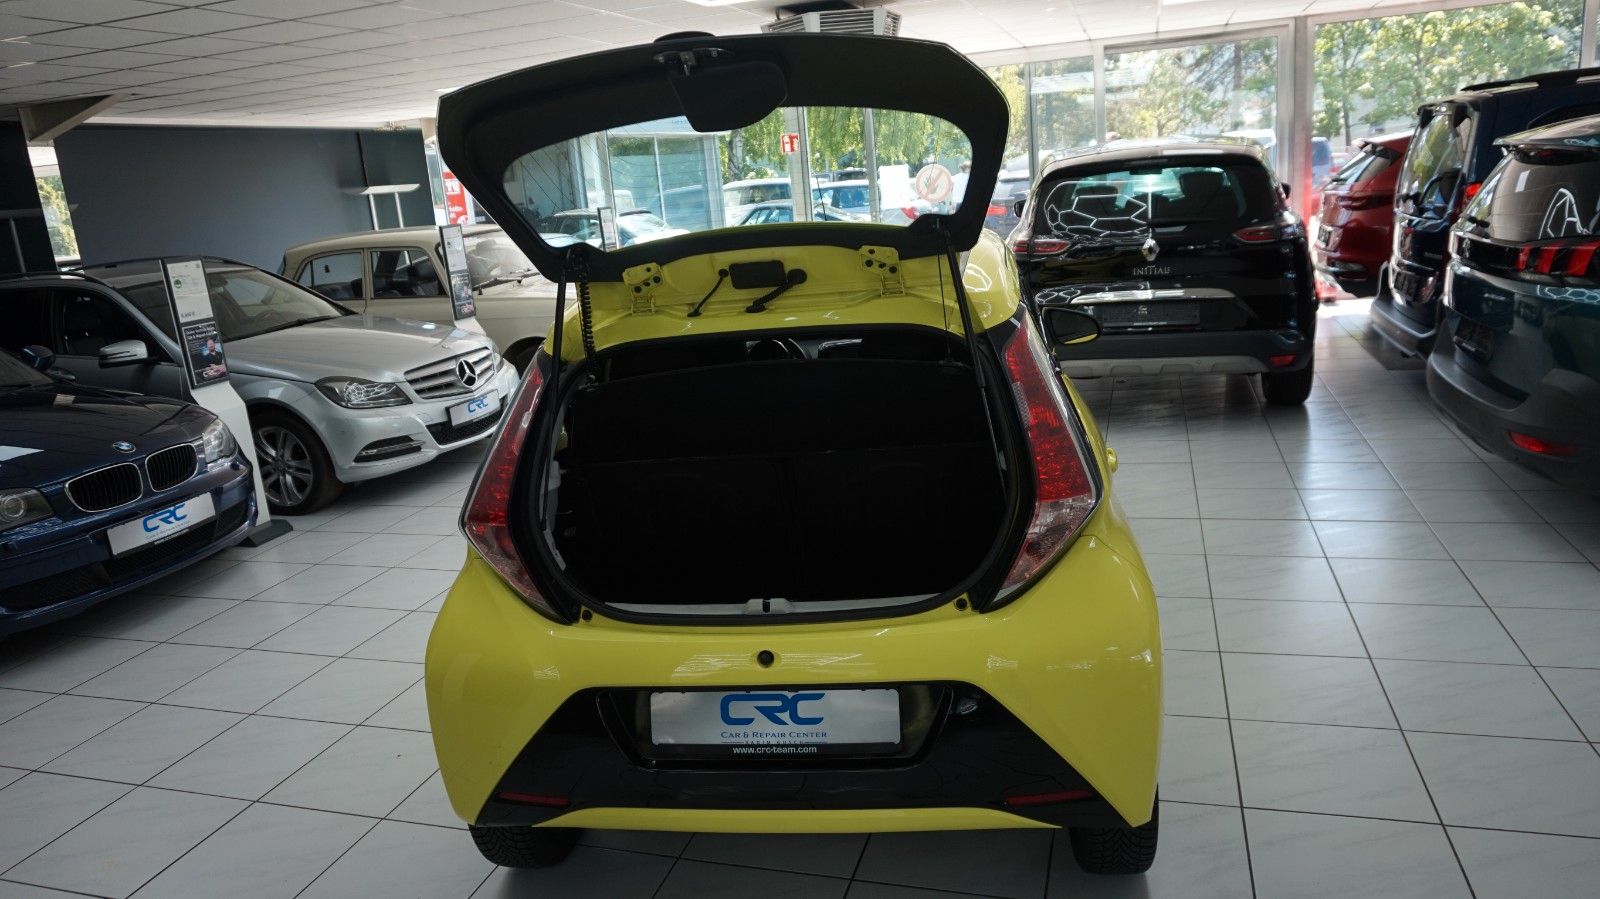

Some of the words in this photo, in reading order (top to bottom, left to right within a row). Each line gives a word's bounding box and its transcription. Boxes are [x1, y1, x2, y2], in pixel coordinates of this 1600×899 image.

[467, 395, 489, 413] CRC
[143, 503, 187, 533] CRC
[721, 693, 825, 725] CRC
[733, 746, 817, 754] www.crc-team.com
